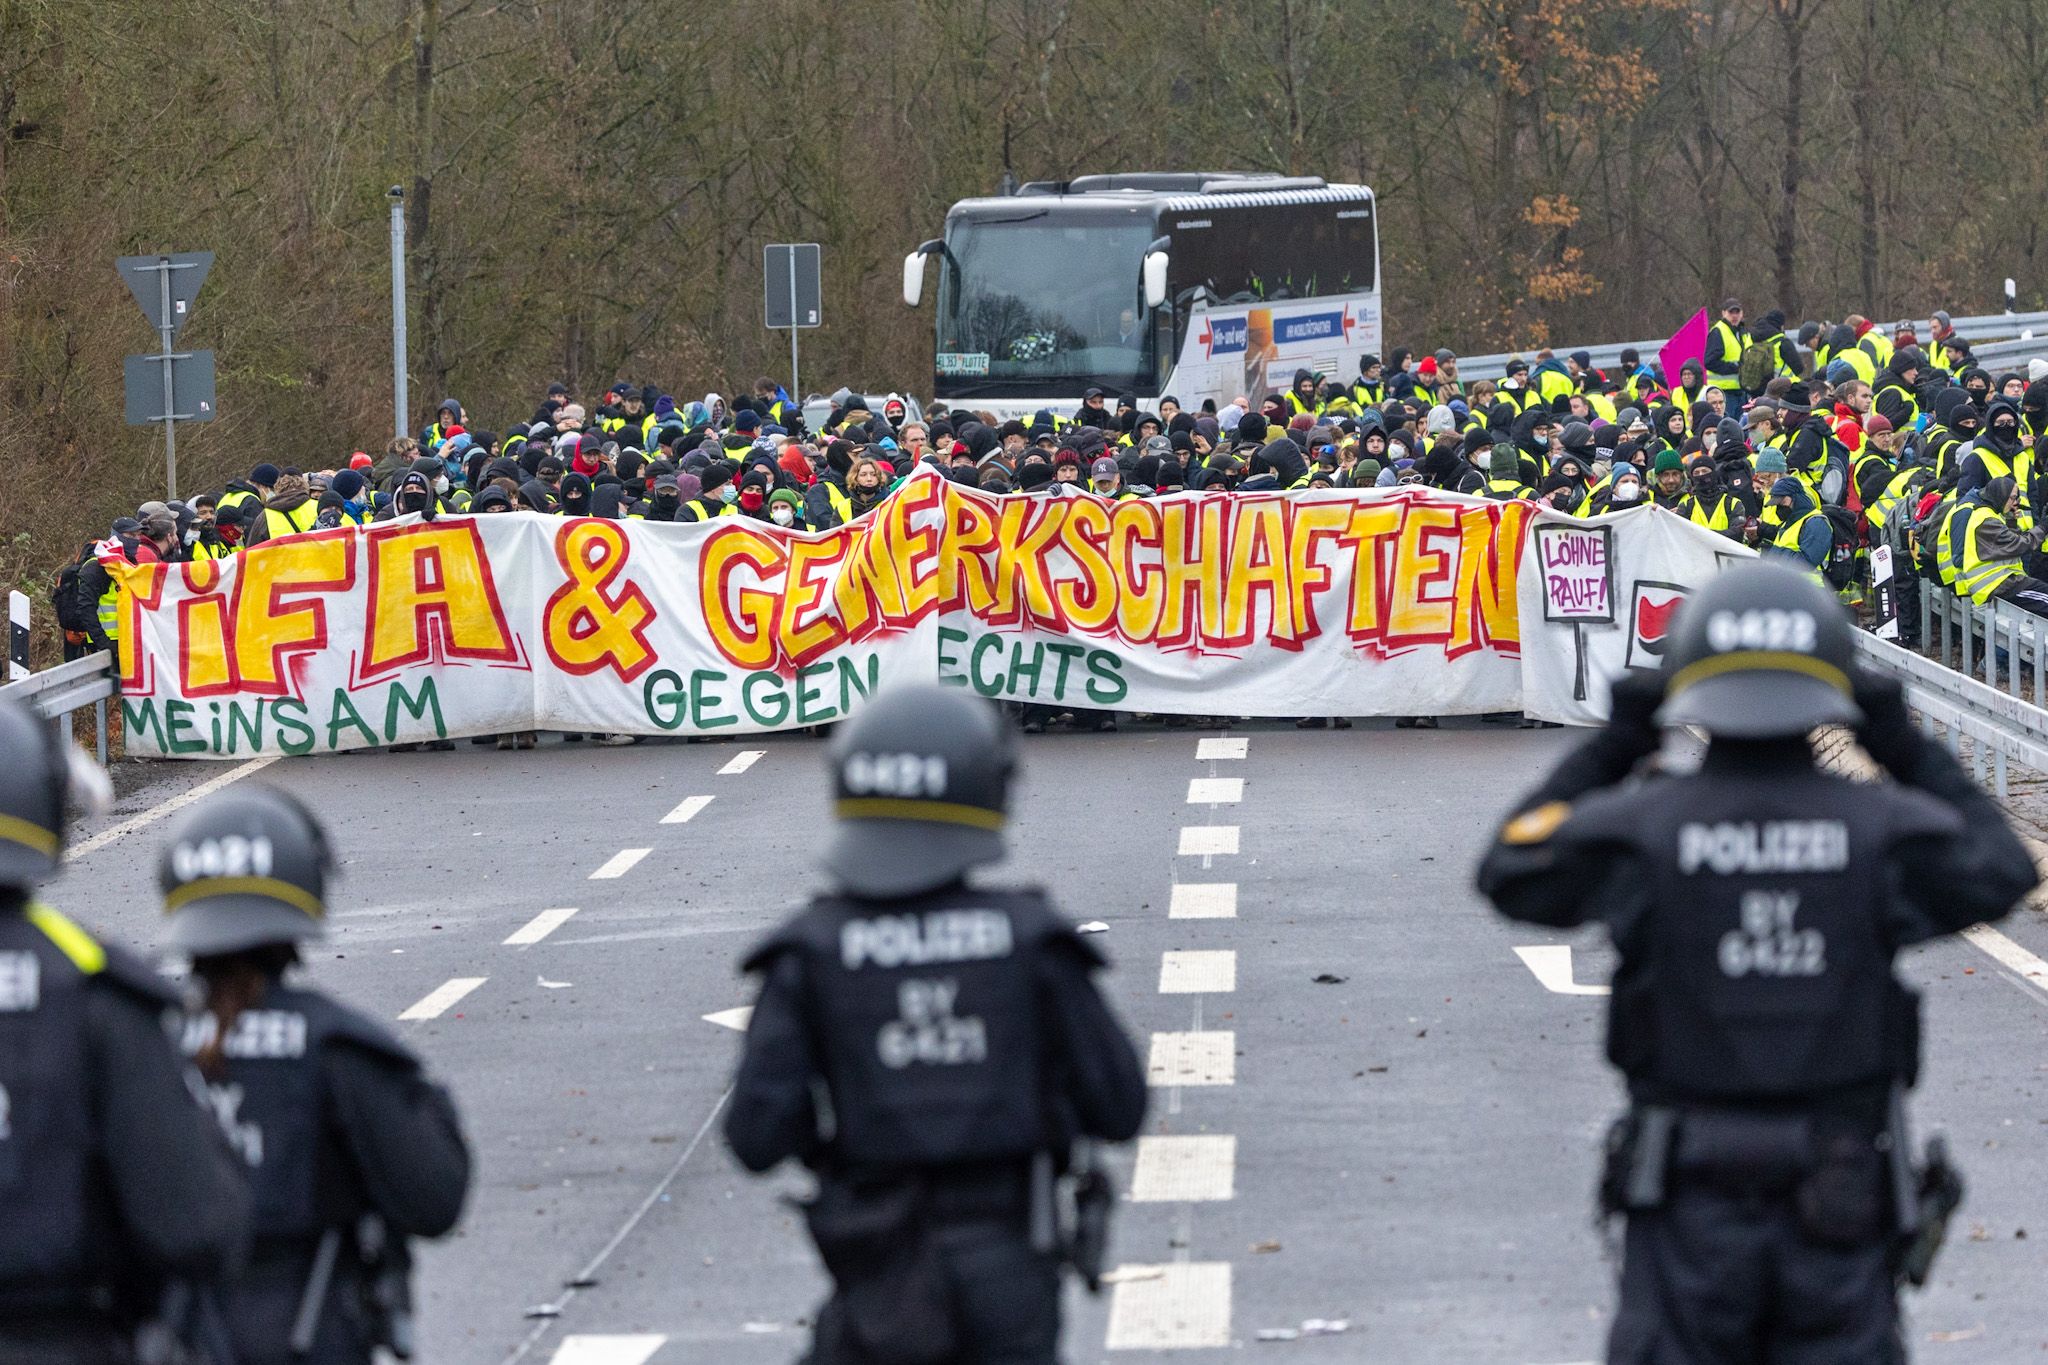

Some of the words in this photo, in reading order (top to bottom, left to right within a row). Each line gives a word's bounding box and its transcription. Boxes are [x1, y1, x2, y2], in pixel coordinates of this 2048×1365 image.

[1544, 532, 1605, 568] LÖHNE
[543, 518, 658, 683] &
[699, 472, 1537, 670] GEWERKSCHAFTEN
[1549, 576, 1608, 611] RAUF!
[644, 653, 879, 730] GEGEN
[1678, 820, 1850, 874] POLIZEI
[840, 908, 1014, 969] POLIZEI
[1740, 890, 1799, 934] BY
